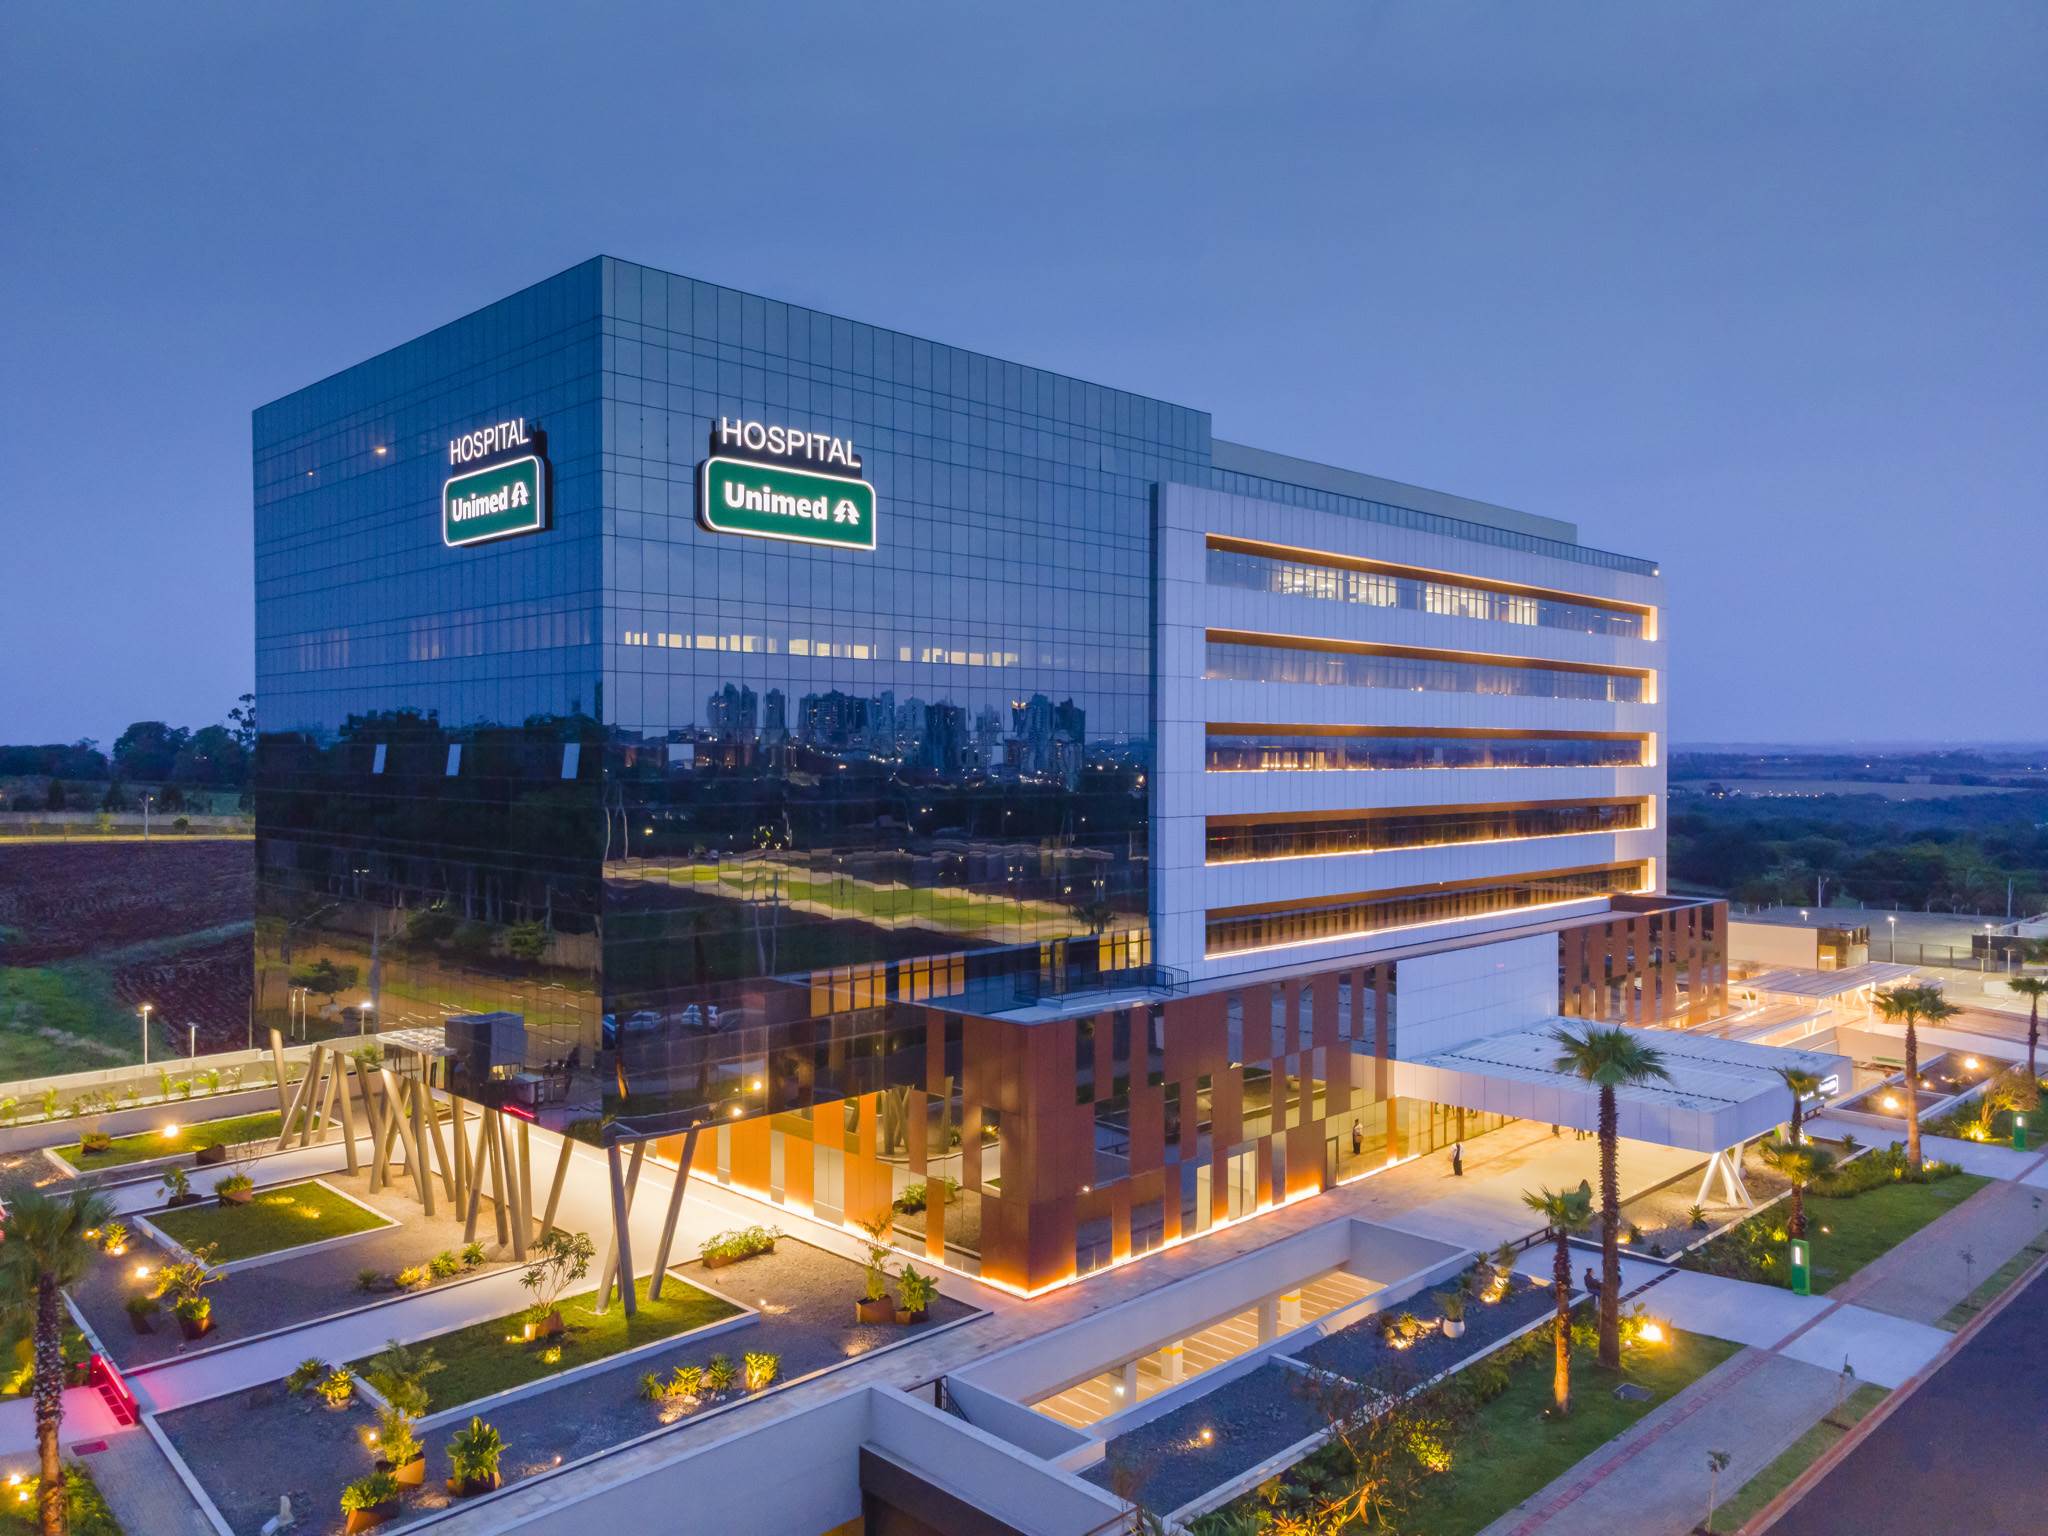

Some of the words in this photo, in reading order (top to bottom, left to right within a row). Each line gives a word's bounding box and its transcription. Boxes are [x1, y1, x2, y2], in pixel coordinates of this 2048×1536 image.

[449, 417, 530, 466] HOSPITAL
[721, 416, 862, 468] HOSPITAL
[452, 485, 509, 522] Unimed
[724, 481, 829, 521] Unimed
